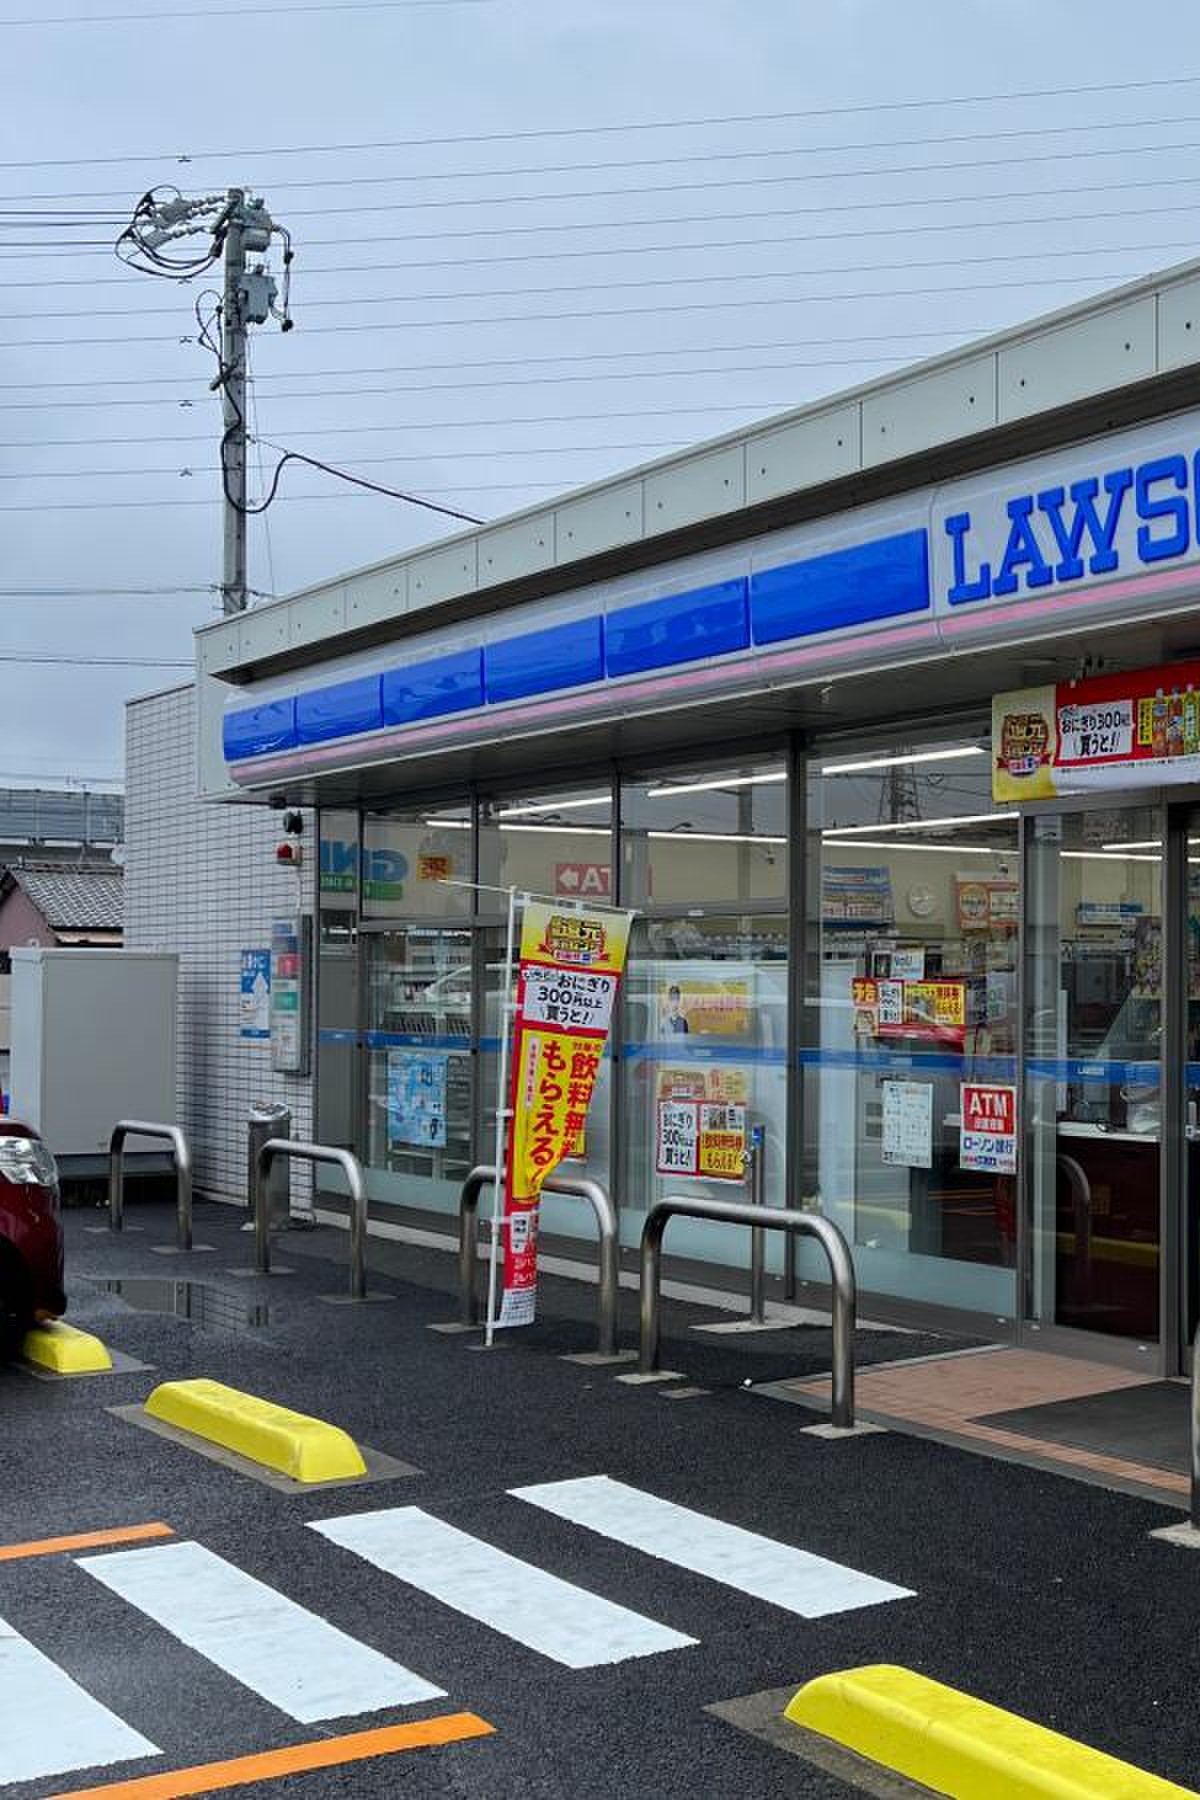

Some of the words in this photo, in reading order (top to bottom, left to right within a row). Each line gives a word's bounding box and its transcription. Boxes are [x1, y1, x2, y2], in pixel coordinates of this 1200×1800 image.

[557, 974, 611, 993] おにぎり
[969, 1092, 1008, 1118] ATM
